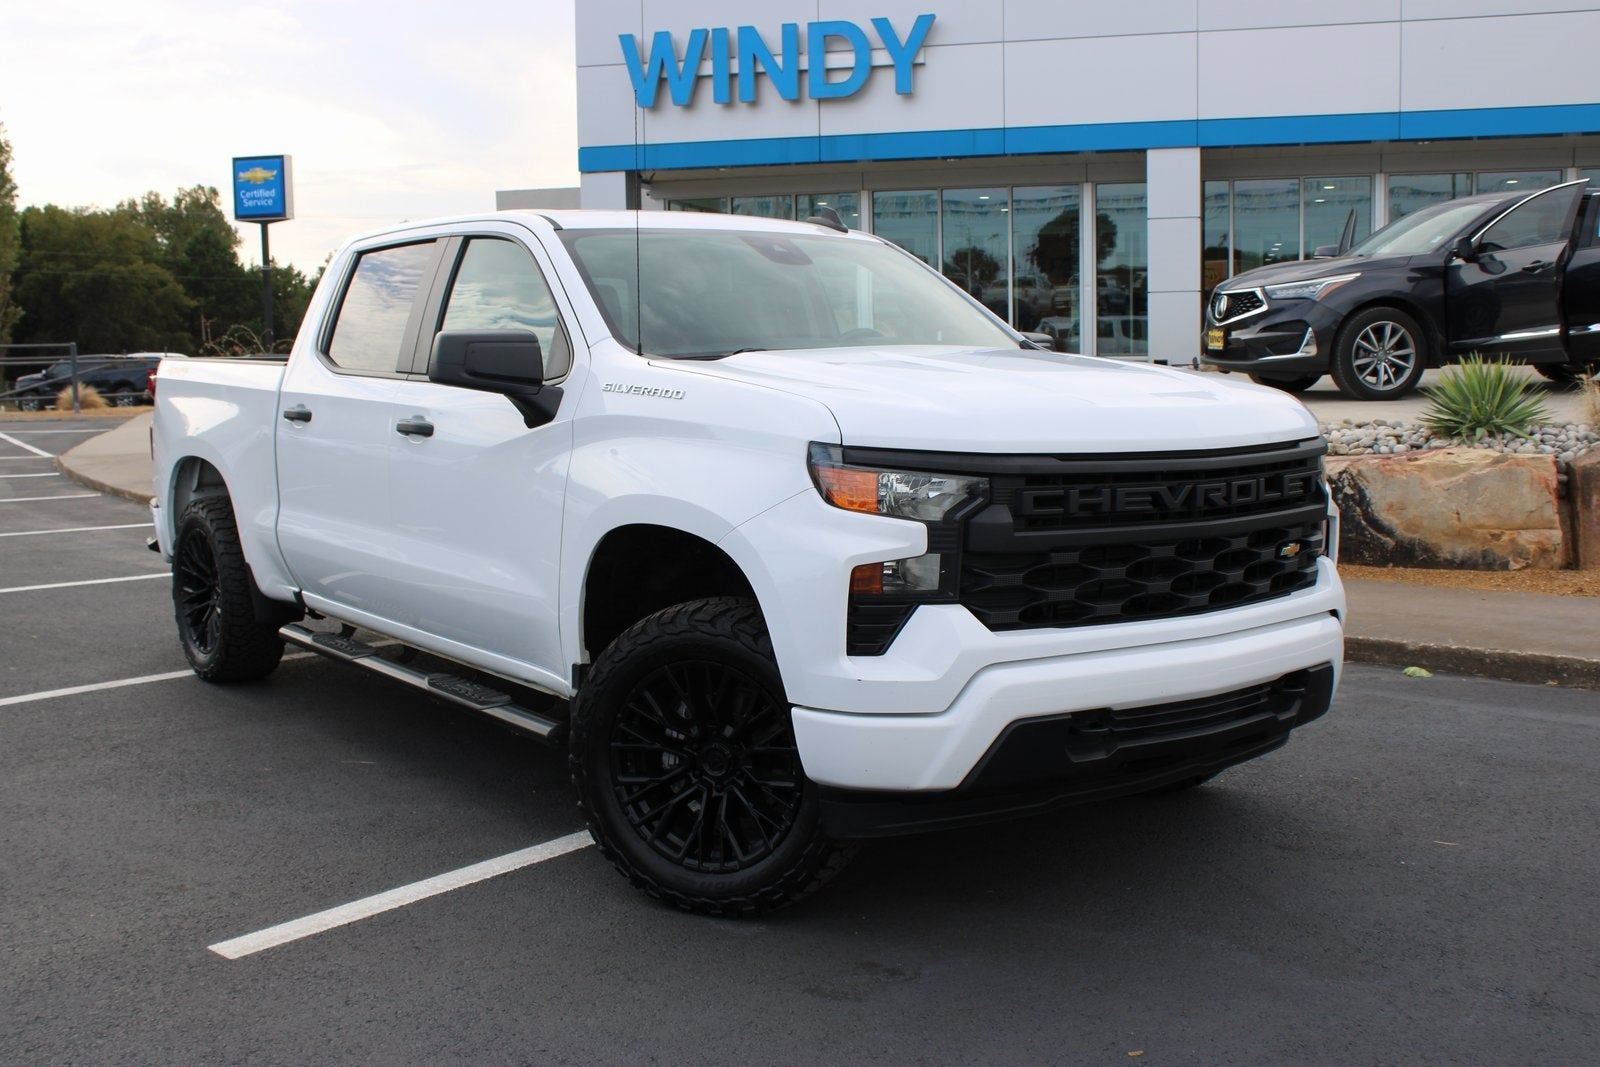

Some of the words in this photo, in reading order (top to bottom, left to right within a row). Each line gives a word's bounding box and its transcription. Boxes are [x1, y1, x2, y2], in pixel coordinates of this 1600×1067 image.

[618, 13, 936, 108] WINDY
[240, 189, 276, 199] Certified
[243, 198, 273, 207] Service
[602, 383, 686, 400] SILVERADO
[1018, 470, 1321, 515] CHEVROLET
